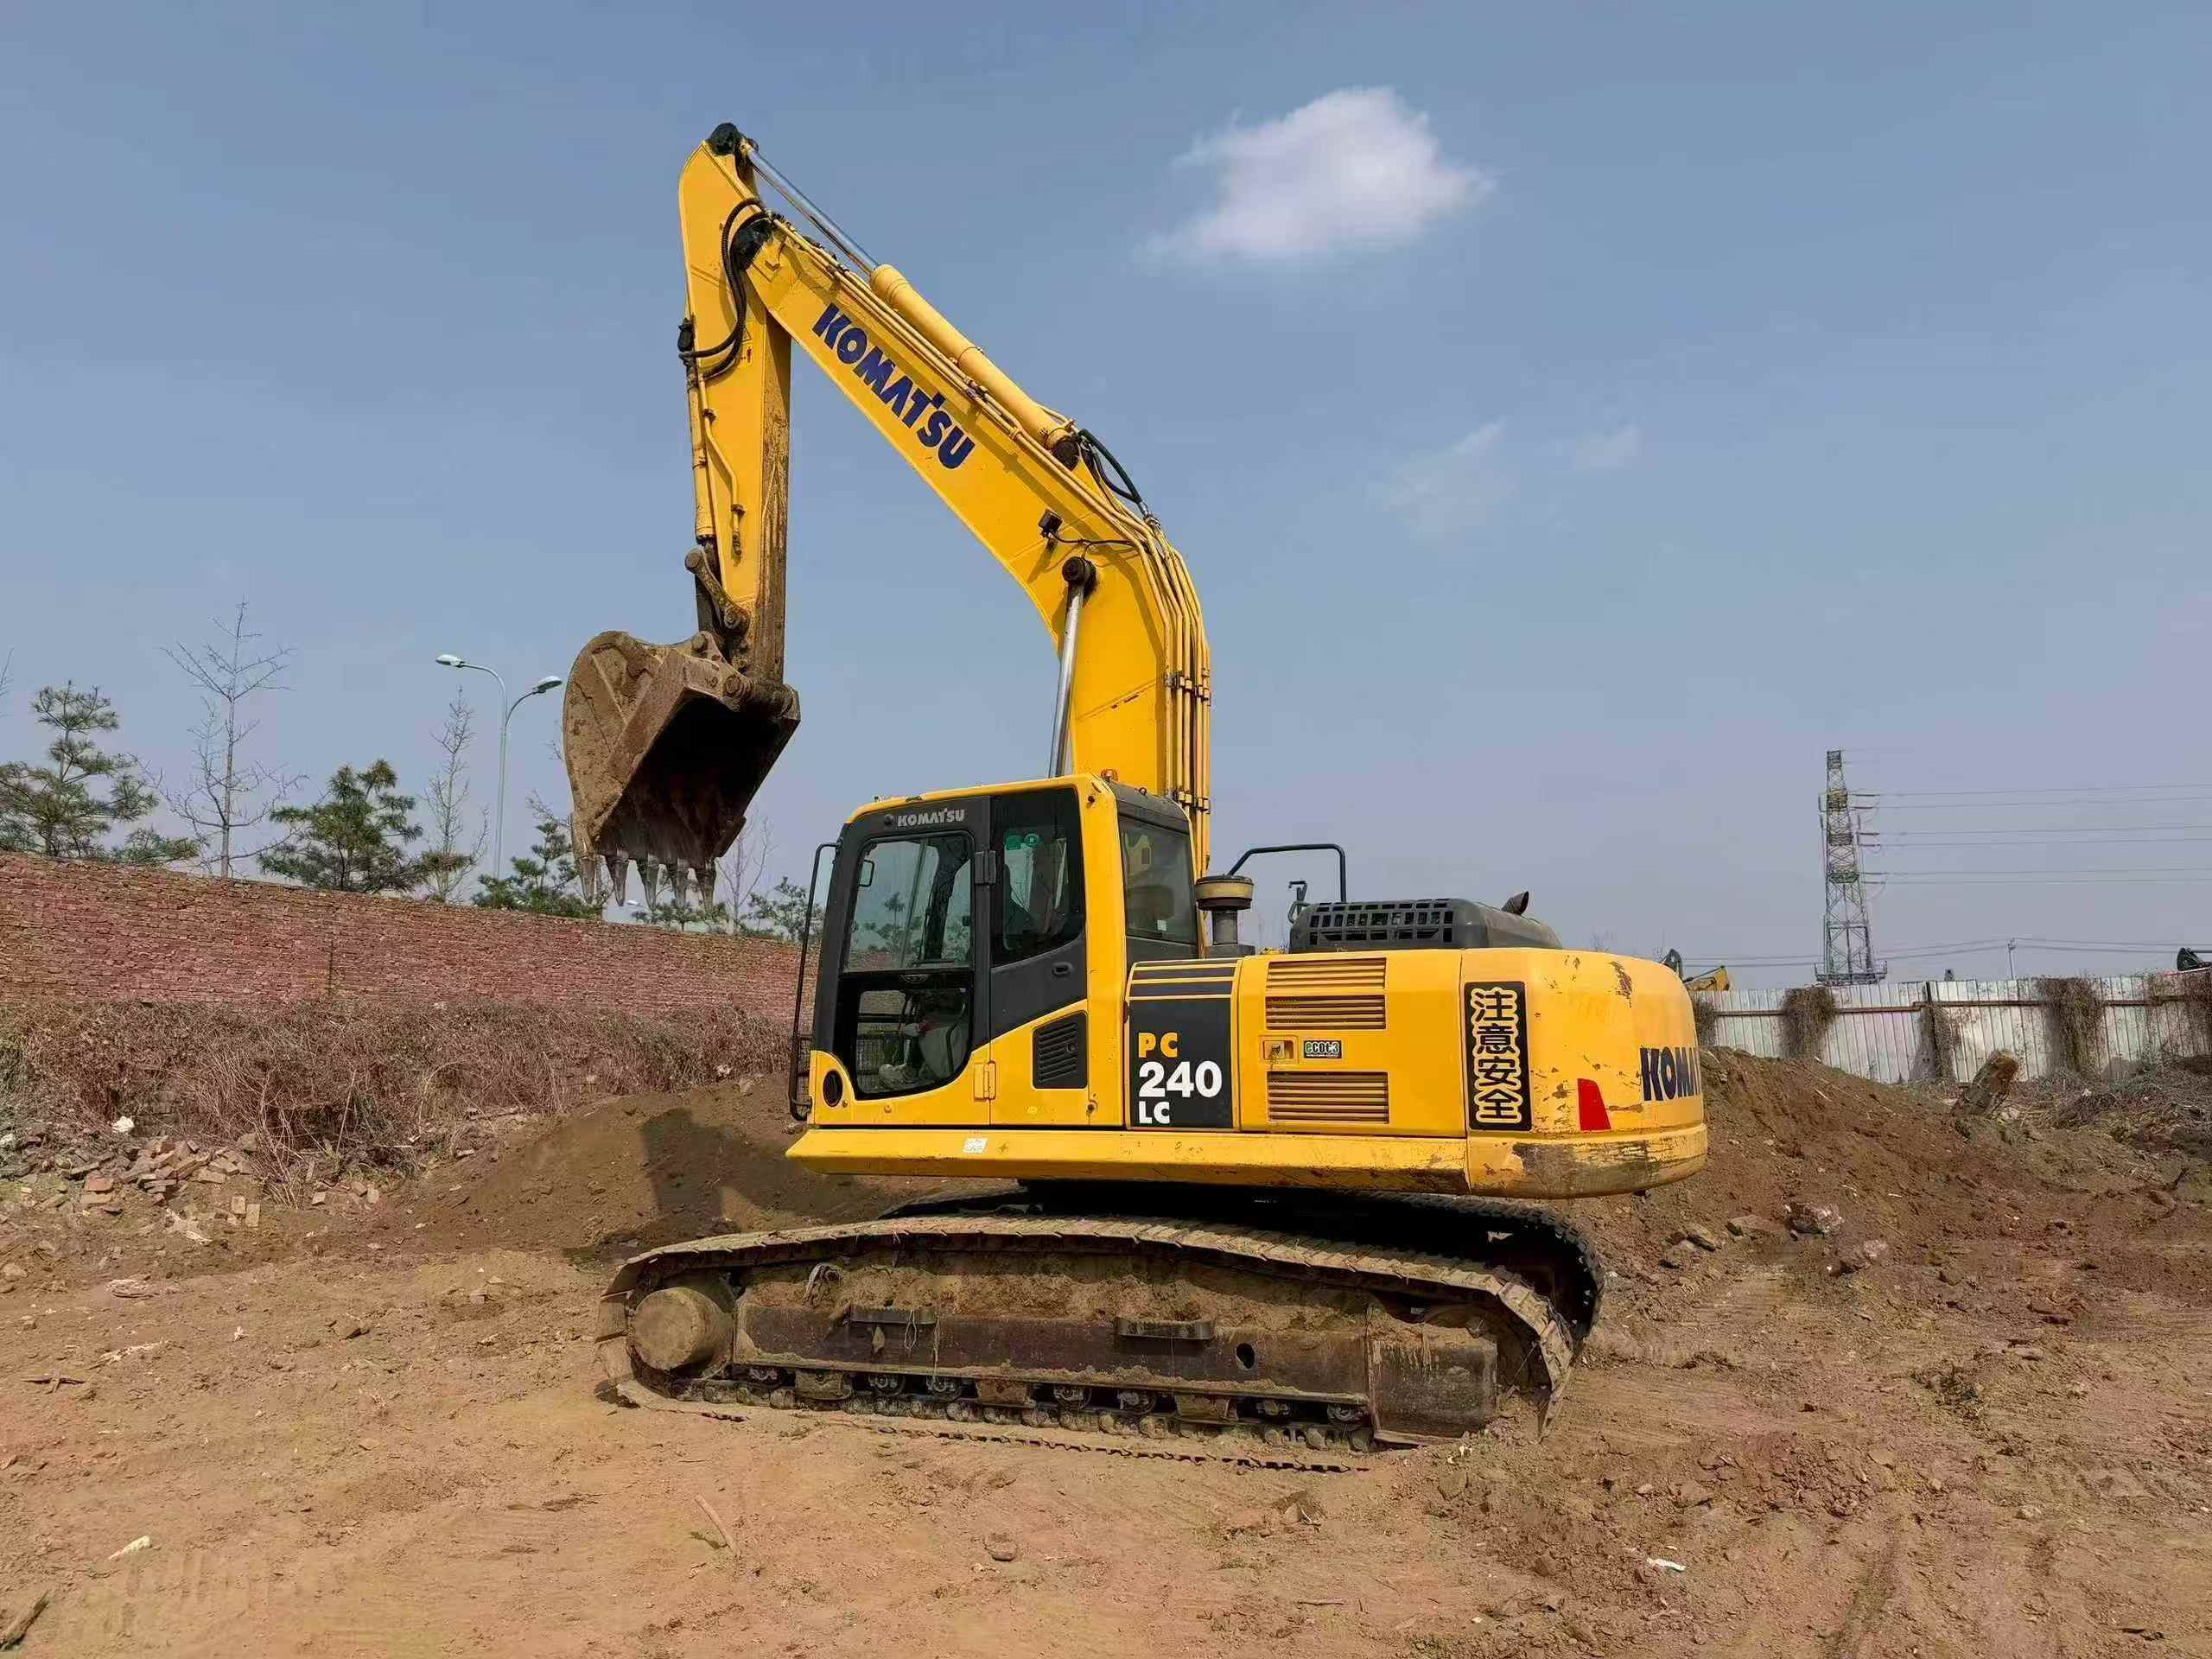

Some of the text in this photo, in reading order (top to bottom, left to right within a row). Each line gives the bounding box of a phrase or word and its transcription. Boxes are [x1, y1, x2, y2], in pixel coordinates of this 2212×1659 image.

[811, 302, 976, 469] KOMATSU
[898, 808, 965, 827] KOMATSU
[1139, 1032, 1178, 1058] PC
[1471, 987, 1523, 1123] 注意安全
[1139, 1060, 1223, 1098] 240
[1139, 1101, 1171, 1124] LC
